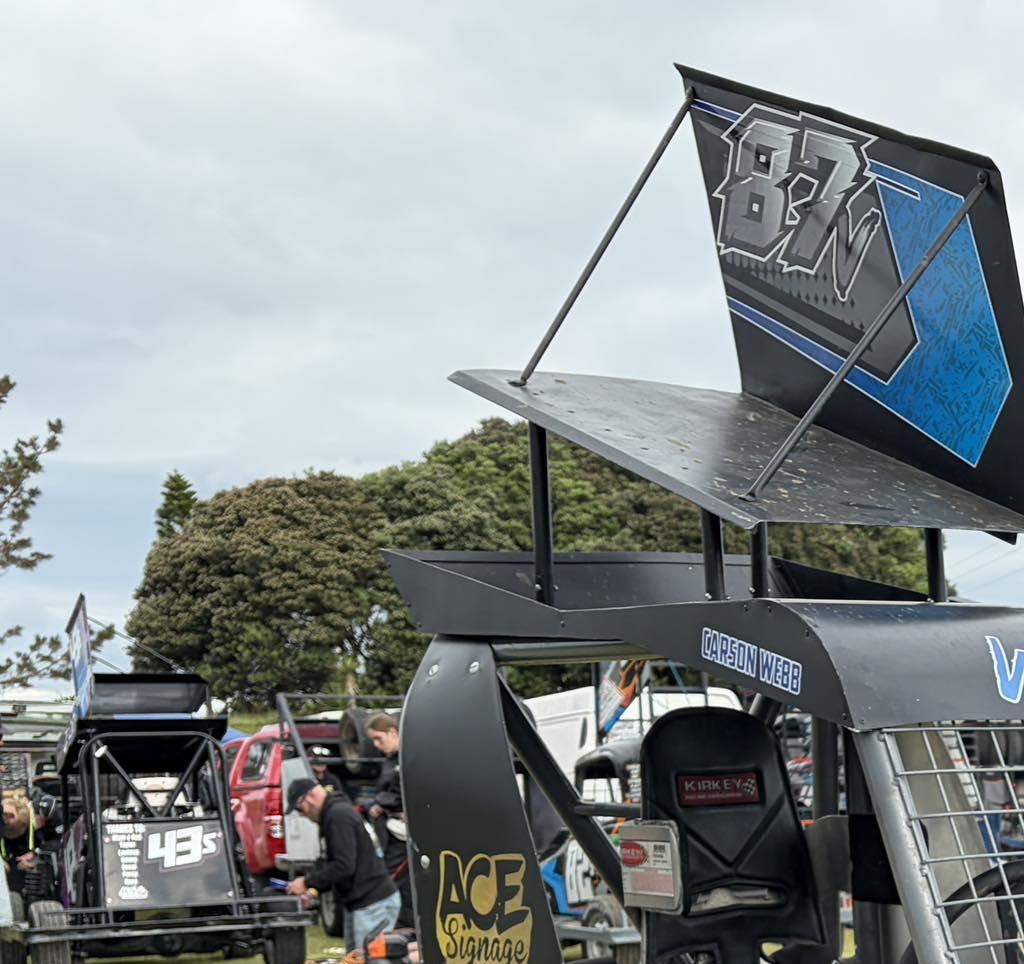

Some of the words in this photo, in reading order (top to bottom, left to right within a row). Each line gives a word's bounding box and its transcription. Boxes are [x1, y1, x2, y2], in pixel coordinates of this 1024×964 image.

[701, 627, 758, 678] CARSON
[759, 648, 802, 695] WEBB
[684, 779, 742, 792] KIRKEY
[437, 851, 531, 935] ACE
